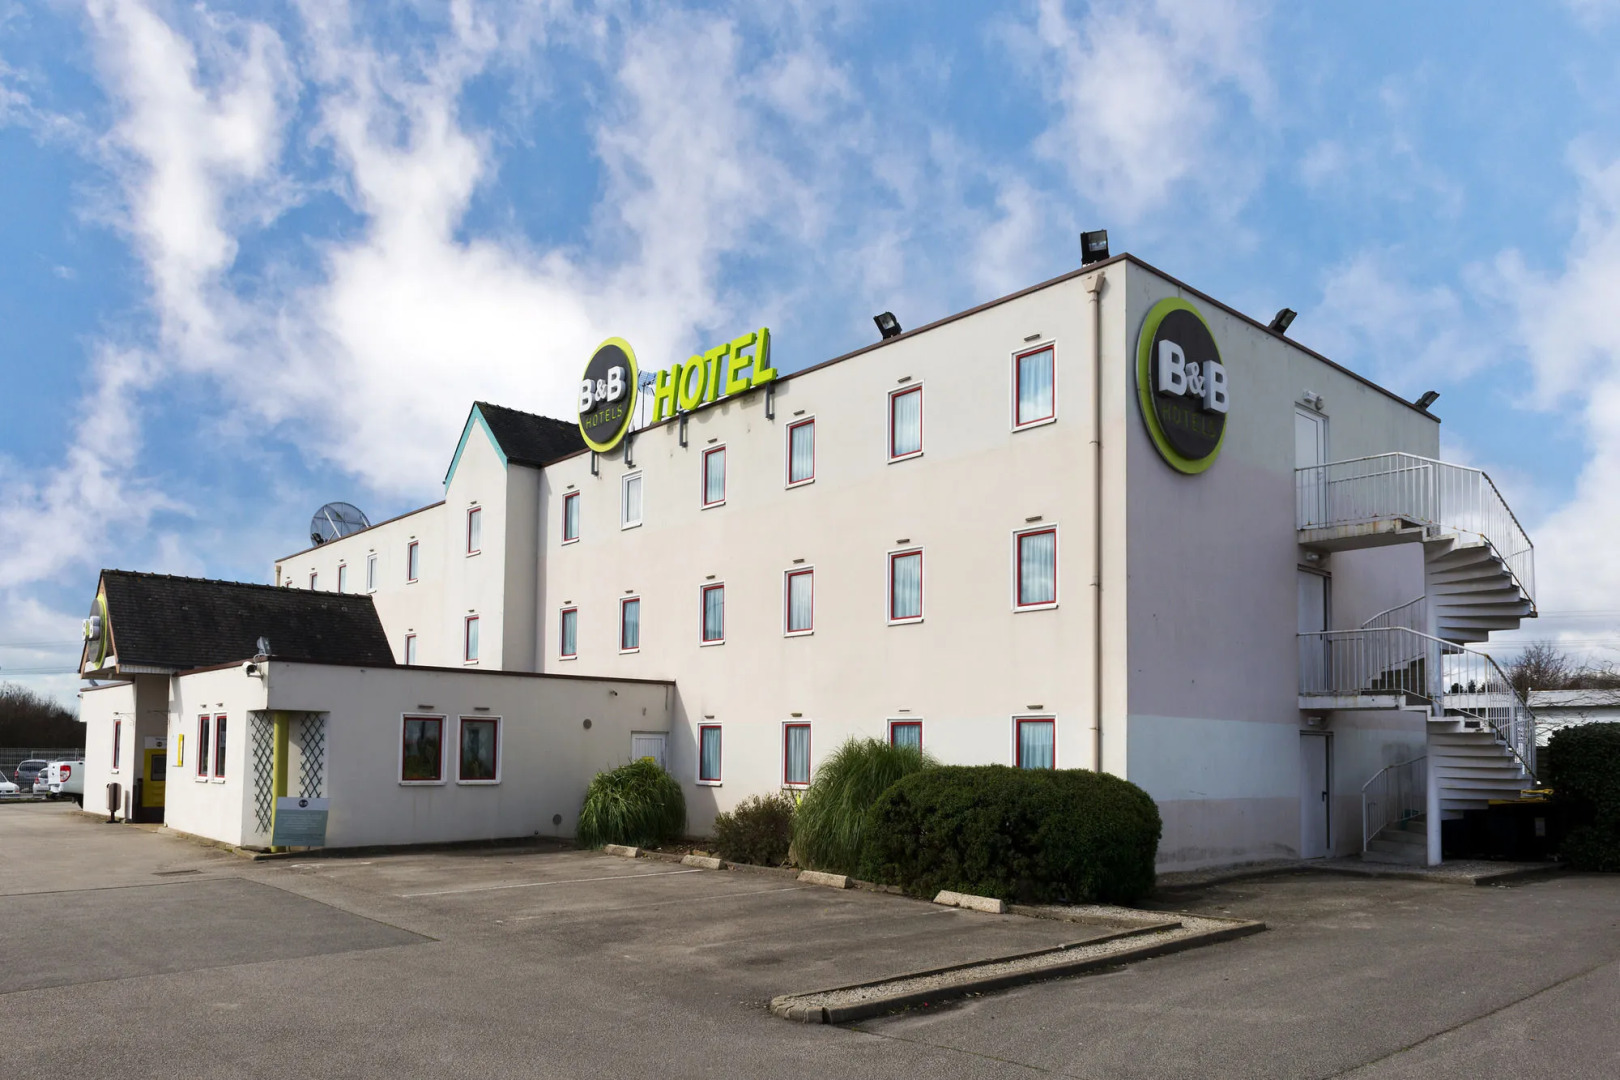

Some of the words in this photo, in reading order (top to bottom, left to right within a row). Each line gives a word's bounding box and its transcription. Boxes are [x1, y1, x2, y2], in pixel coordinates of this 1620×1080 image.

[579, 366, 626, 413] B&B
[653, 327, 777, 422] HOTEL
[1159, 339, 1229, 414] B&B
[585, 404, 623, 429] HOTELS
[1162, 403, 1217, 438] HOTELS
